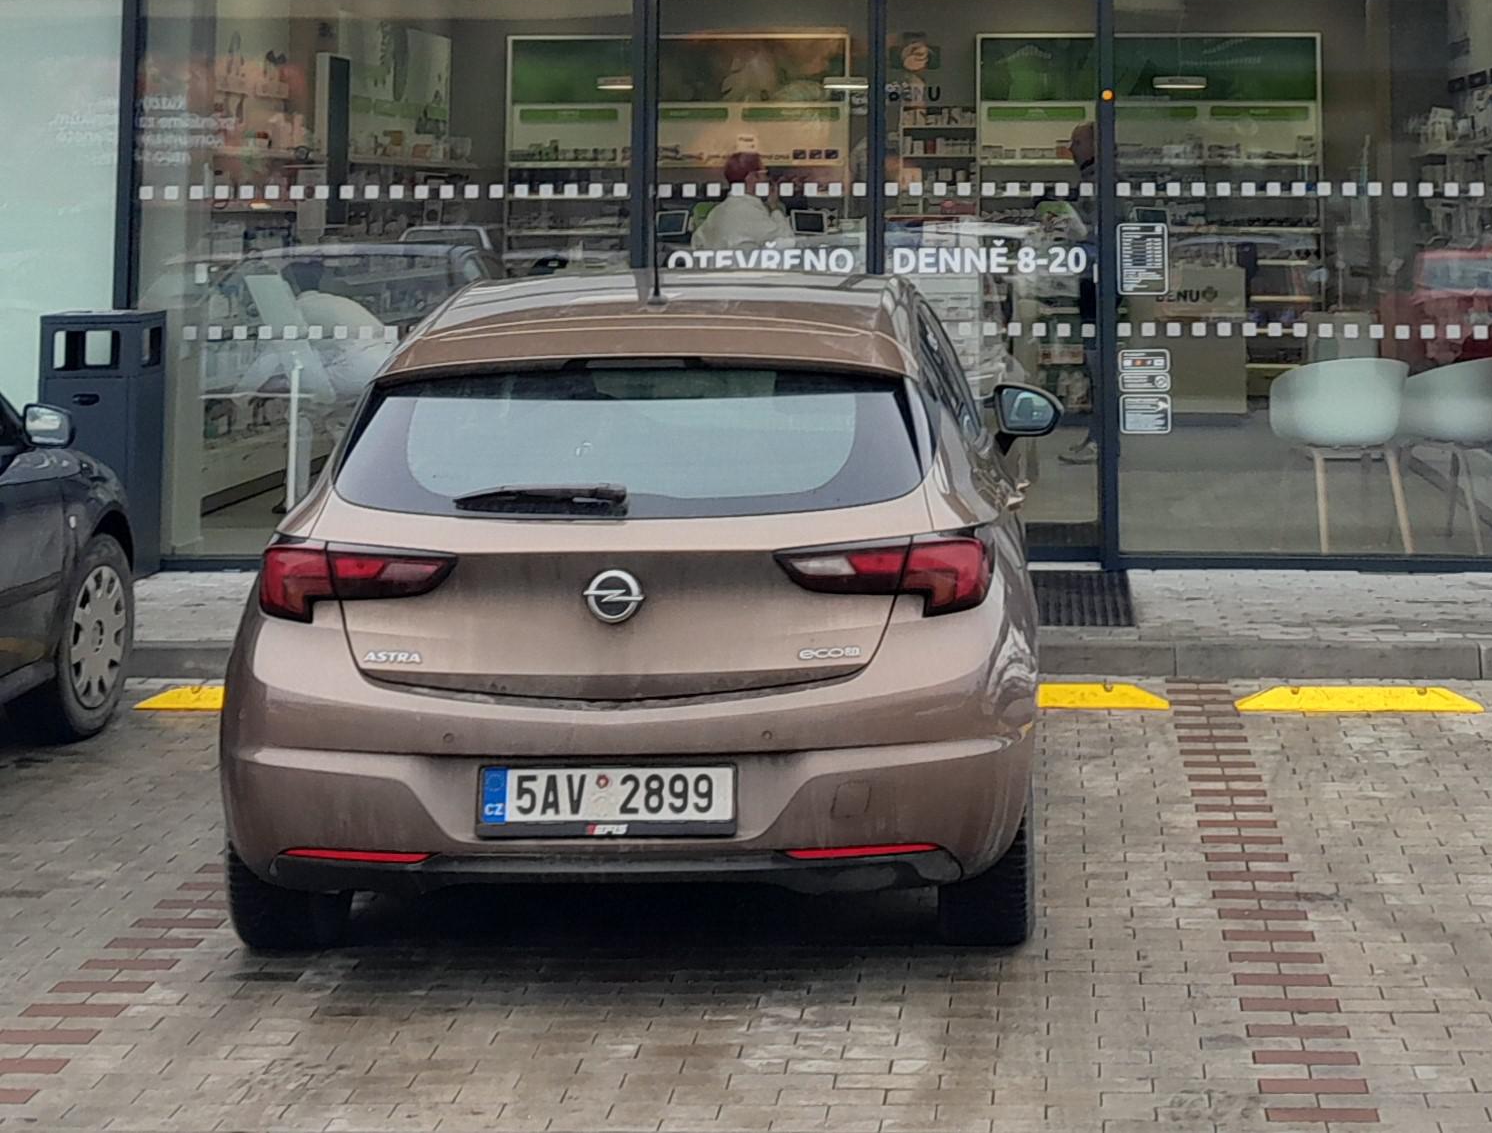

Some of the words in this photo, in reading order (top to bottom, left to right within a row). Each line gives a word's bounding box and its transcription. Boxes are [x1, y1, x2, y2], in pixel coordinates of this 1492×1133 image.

[893, 240, 1008, 274] DENNĚ
[1018, 246, 1087, 274] 8-20
[363, 650, 422, 663] ASTRA
[516, 774, 586, 815] 5AV
[619, 774, 714, 814] 2899
[484, 803, 504, 816] CZ
